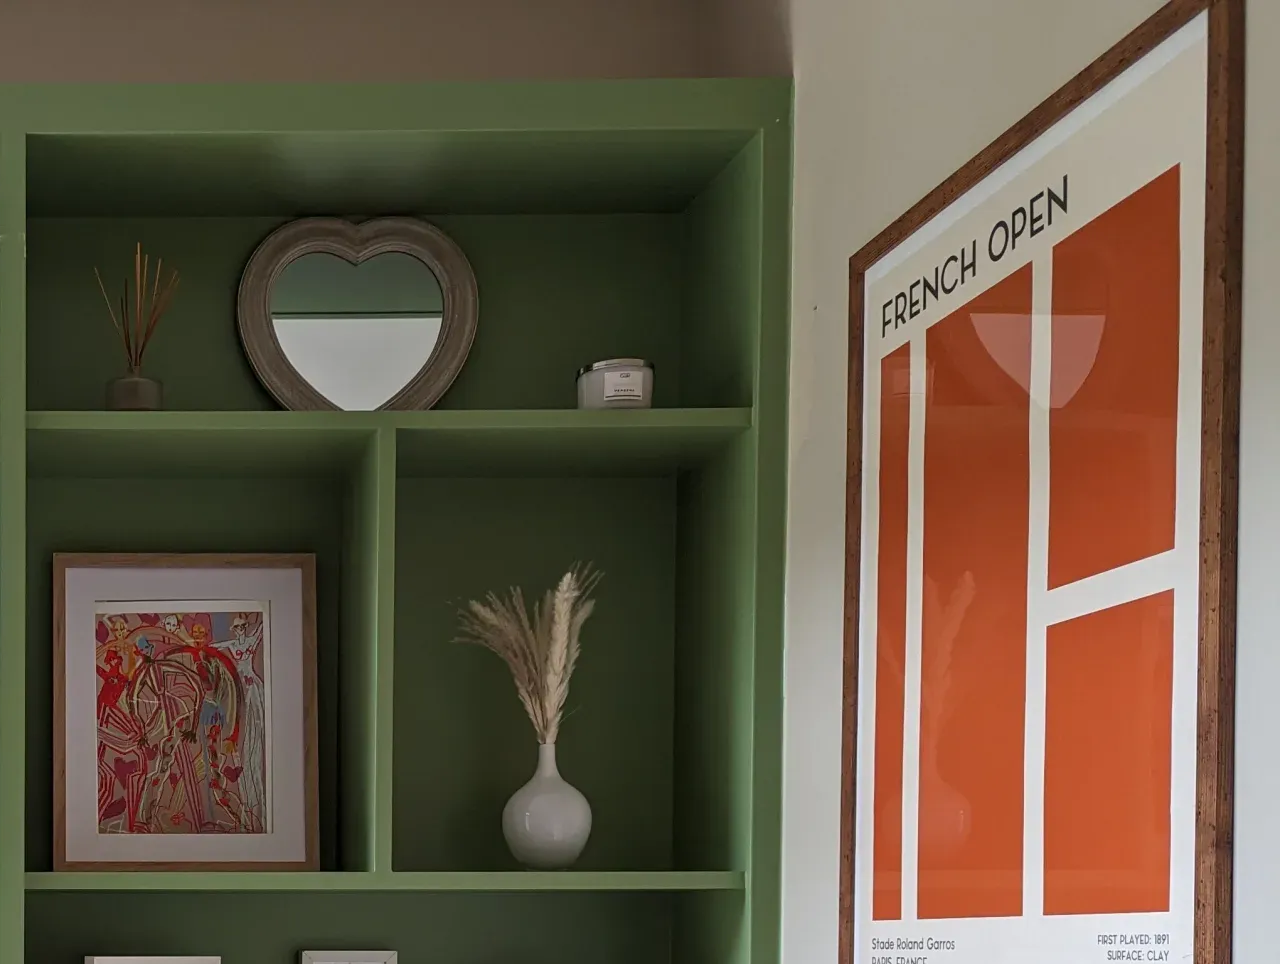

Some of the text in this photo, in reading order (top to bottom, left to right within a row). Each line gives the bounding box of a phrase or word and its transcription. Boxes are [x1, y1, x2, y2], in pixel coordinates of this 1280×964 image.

[882, 174, 1067, 338] FRENCH OPEN
[871, 937, 955, 950] Stade Roland Garros
[1097, 934, 1170, 945] FIRST PLAYED: 1891
[1107, 950, 1169, 962] SURFACE: CLAY
